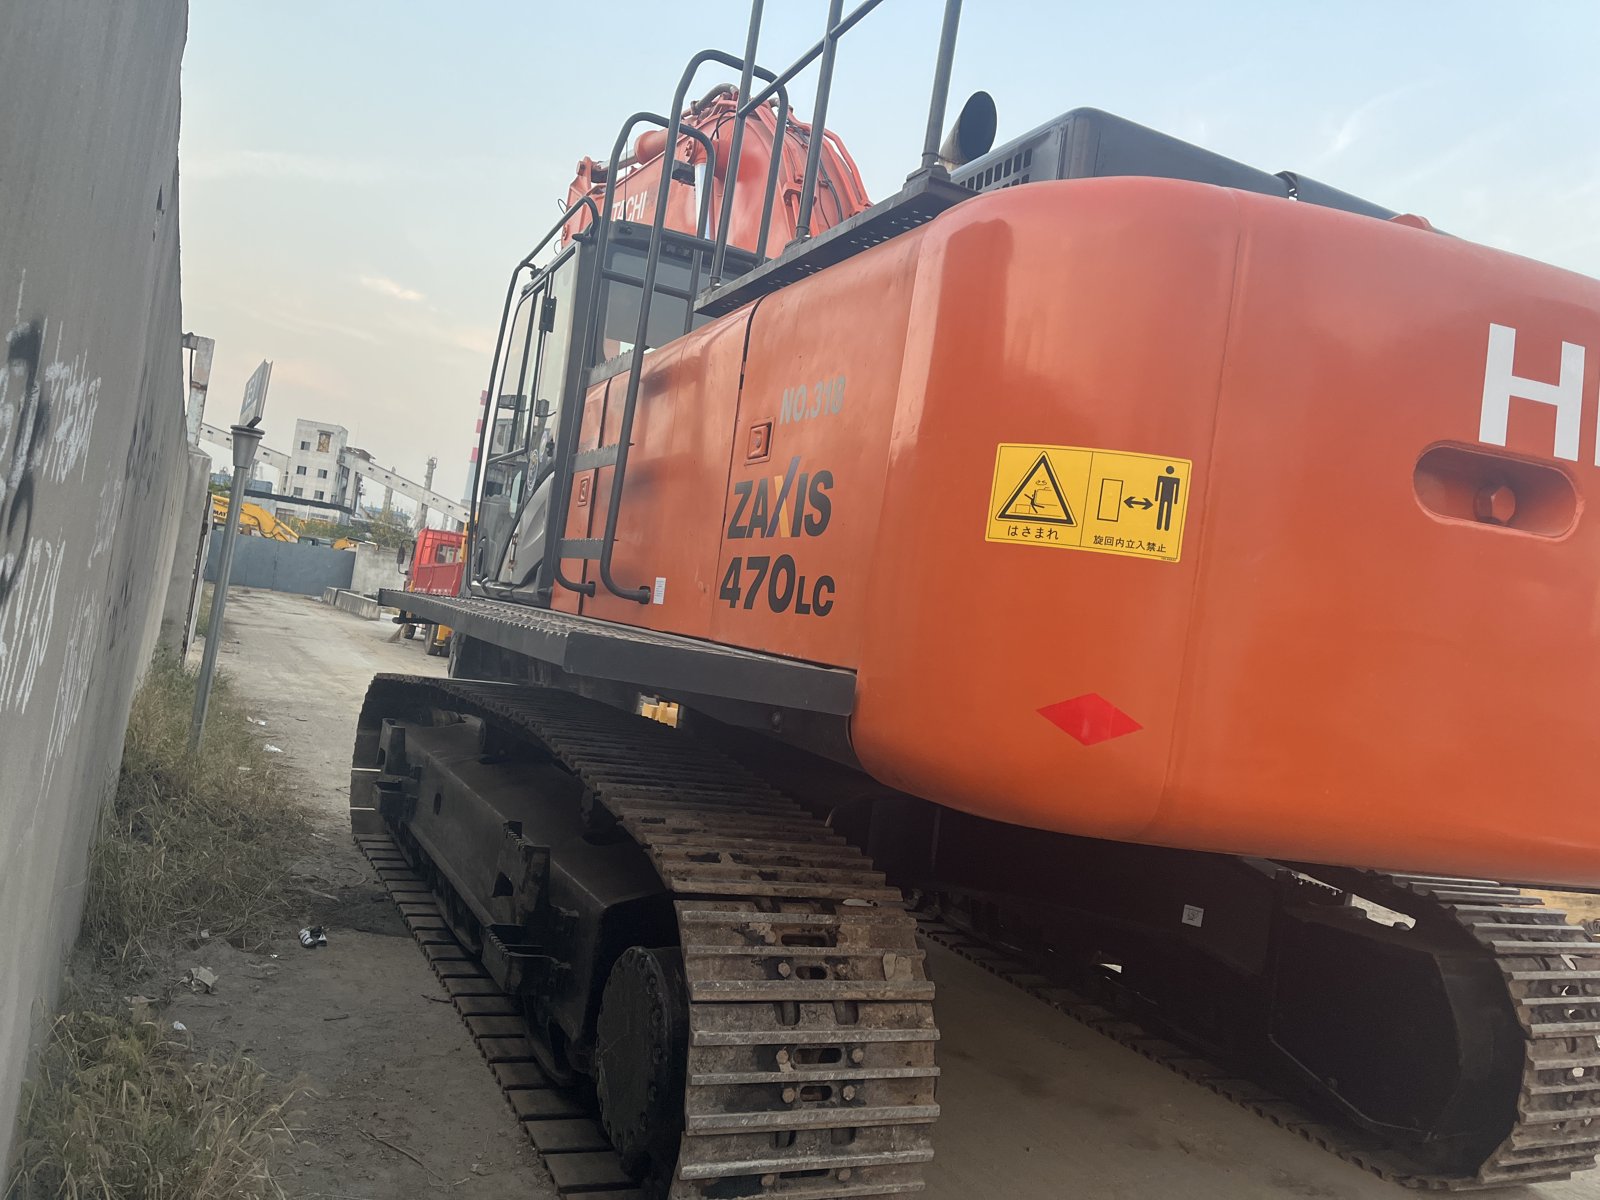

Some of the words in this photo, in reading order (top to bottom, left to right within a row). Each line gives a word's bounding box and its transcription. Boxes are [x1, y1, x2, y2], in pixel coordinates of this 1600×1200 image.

[610, 190, 647, 221] TACHI
[779, 374, 846, 424] NO.318
[1479, 323, 1600, 466] H
[727, 455, 834, 539] ZAXIS
[1007, 525, 1059, 540] はさまれ
[1093, 534, 1167, 553] 旋回内立入禁止
